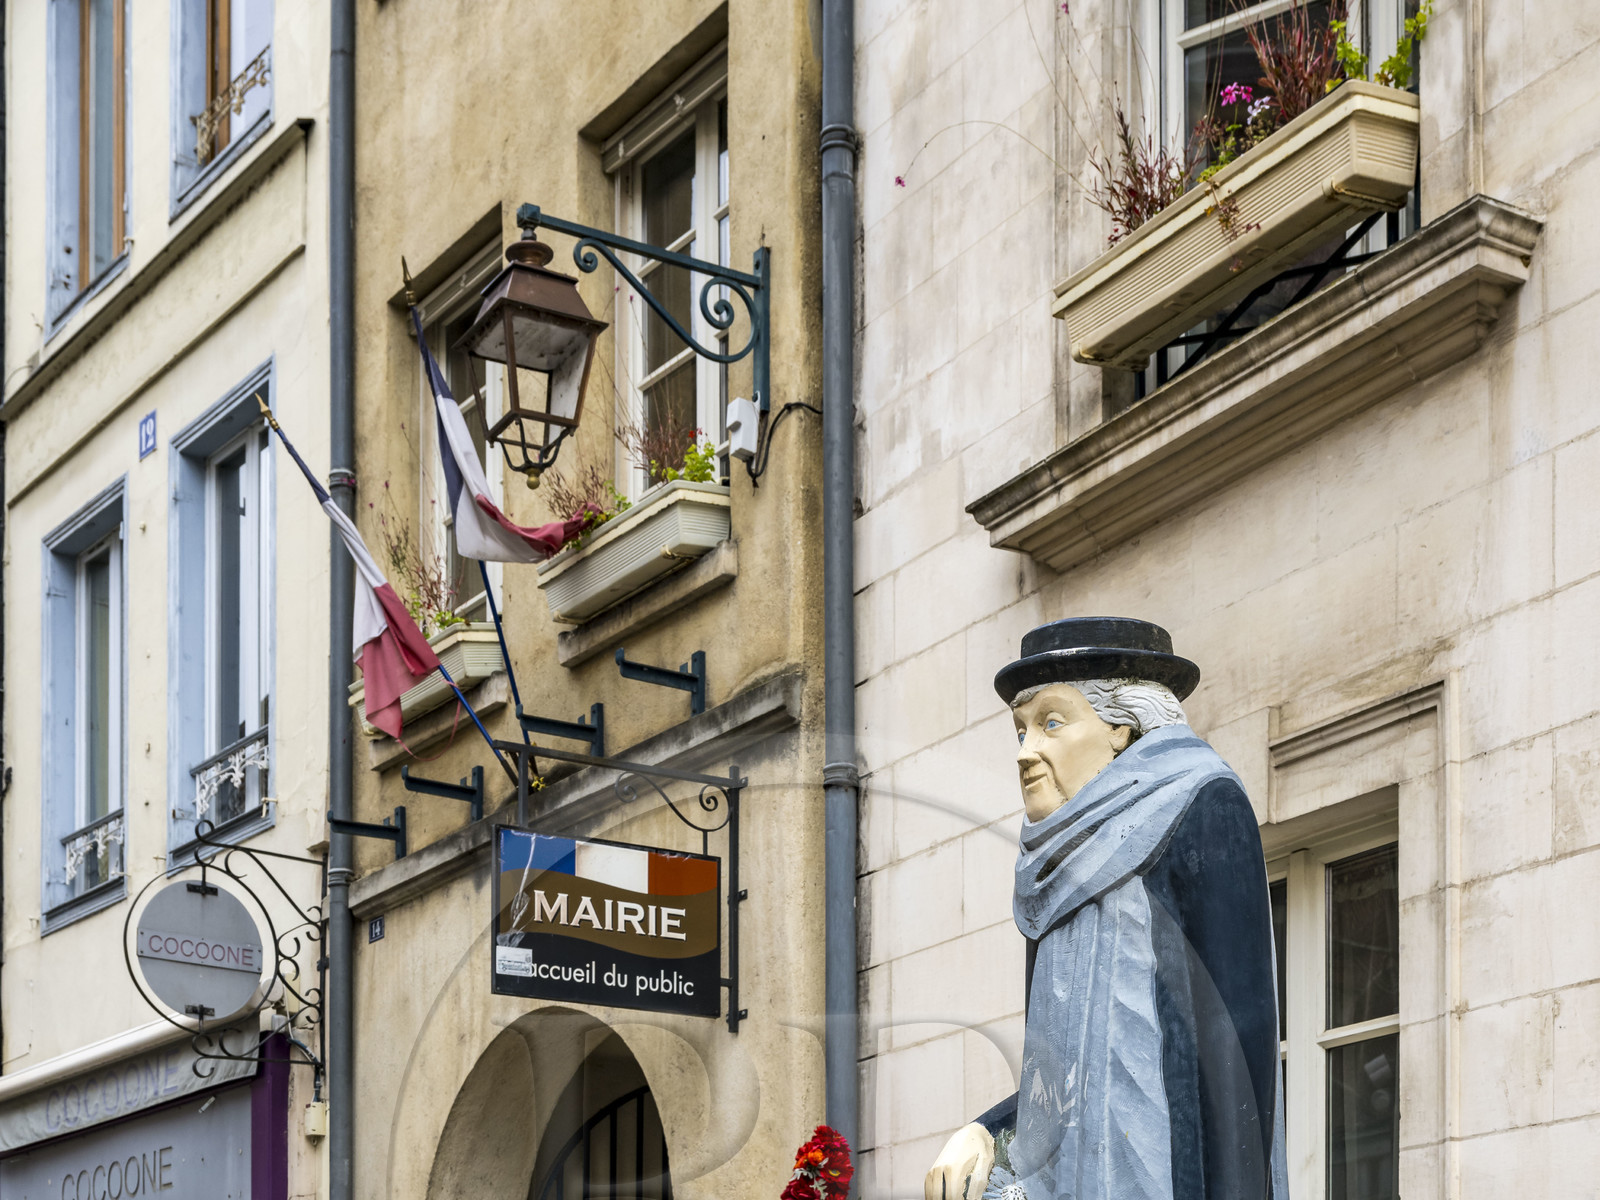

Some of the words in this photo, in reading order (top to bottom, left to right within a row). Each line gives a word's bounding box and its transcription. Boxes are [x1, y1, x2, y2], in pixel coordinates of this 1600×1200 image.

[141, 418, 154, 453] 12
[372, 920, 381, 938] 14
[533, 889, 687, 941] MAIRIE
[148, 935, 254, 966] COCOONE
[530, 960, 596, 985] accueil
[604, 963, 628, 988] du
[636, 969, 695, 996] public
[45, 1049, 180, 1133] COCOONE
